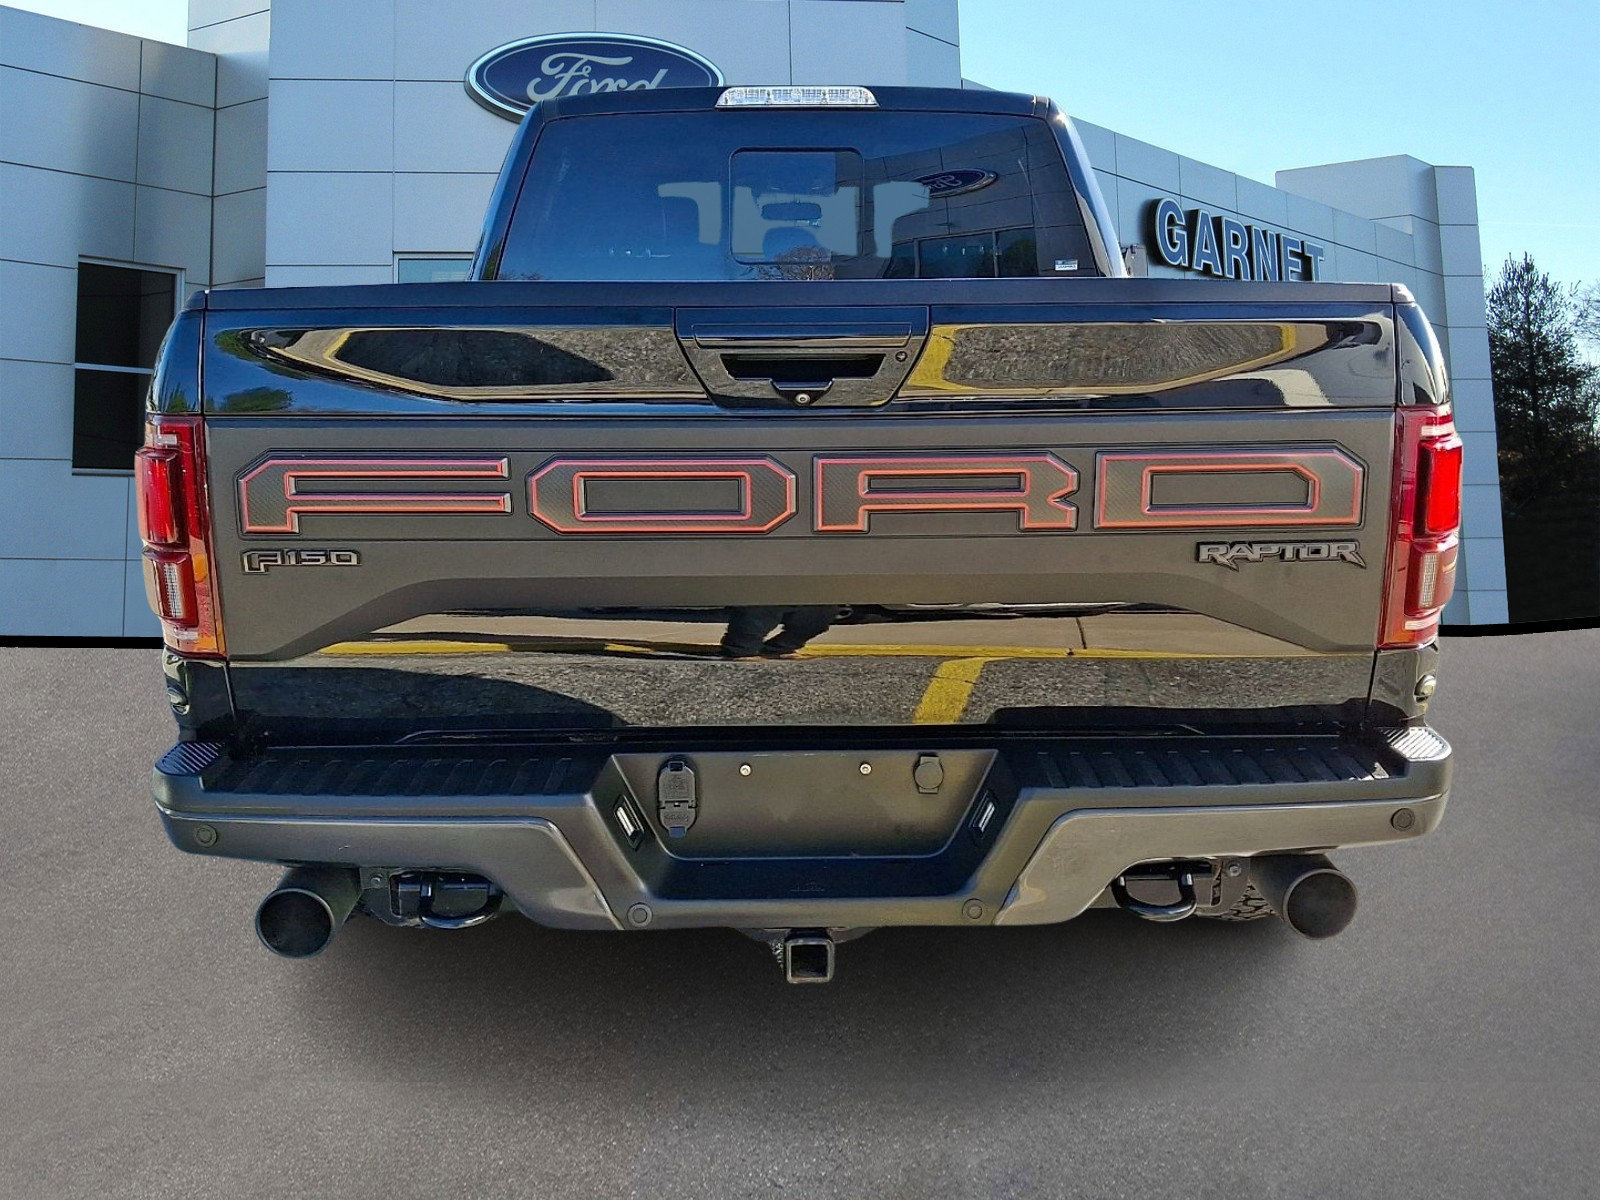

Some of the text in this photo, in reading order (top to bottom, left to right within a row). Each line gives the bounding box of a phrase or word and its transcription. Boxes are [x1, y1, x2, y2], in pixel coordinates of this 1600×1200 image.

[1154, 197, 1325, 281] GARNET
[237, 448, 1366, 534] FORD
[1197, 540, 1366, 571] RAPTOR
